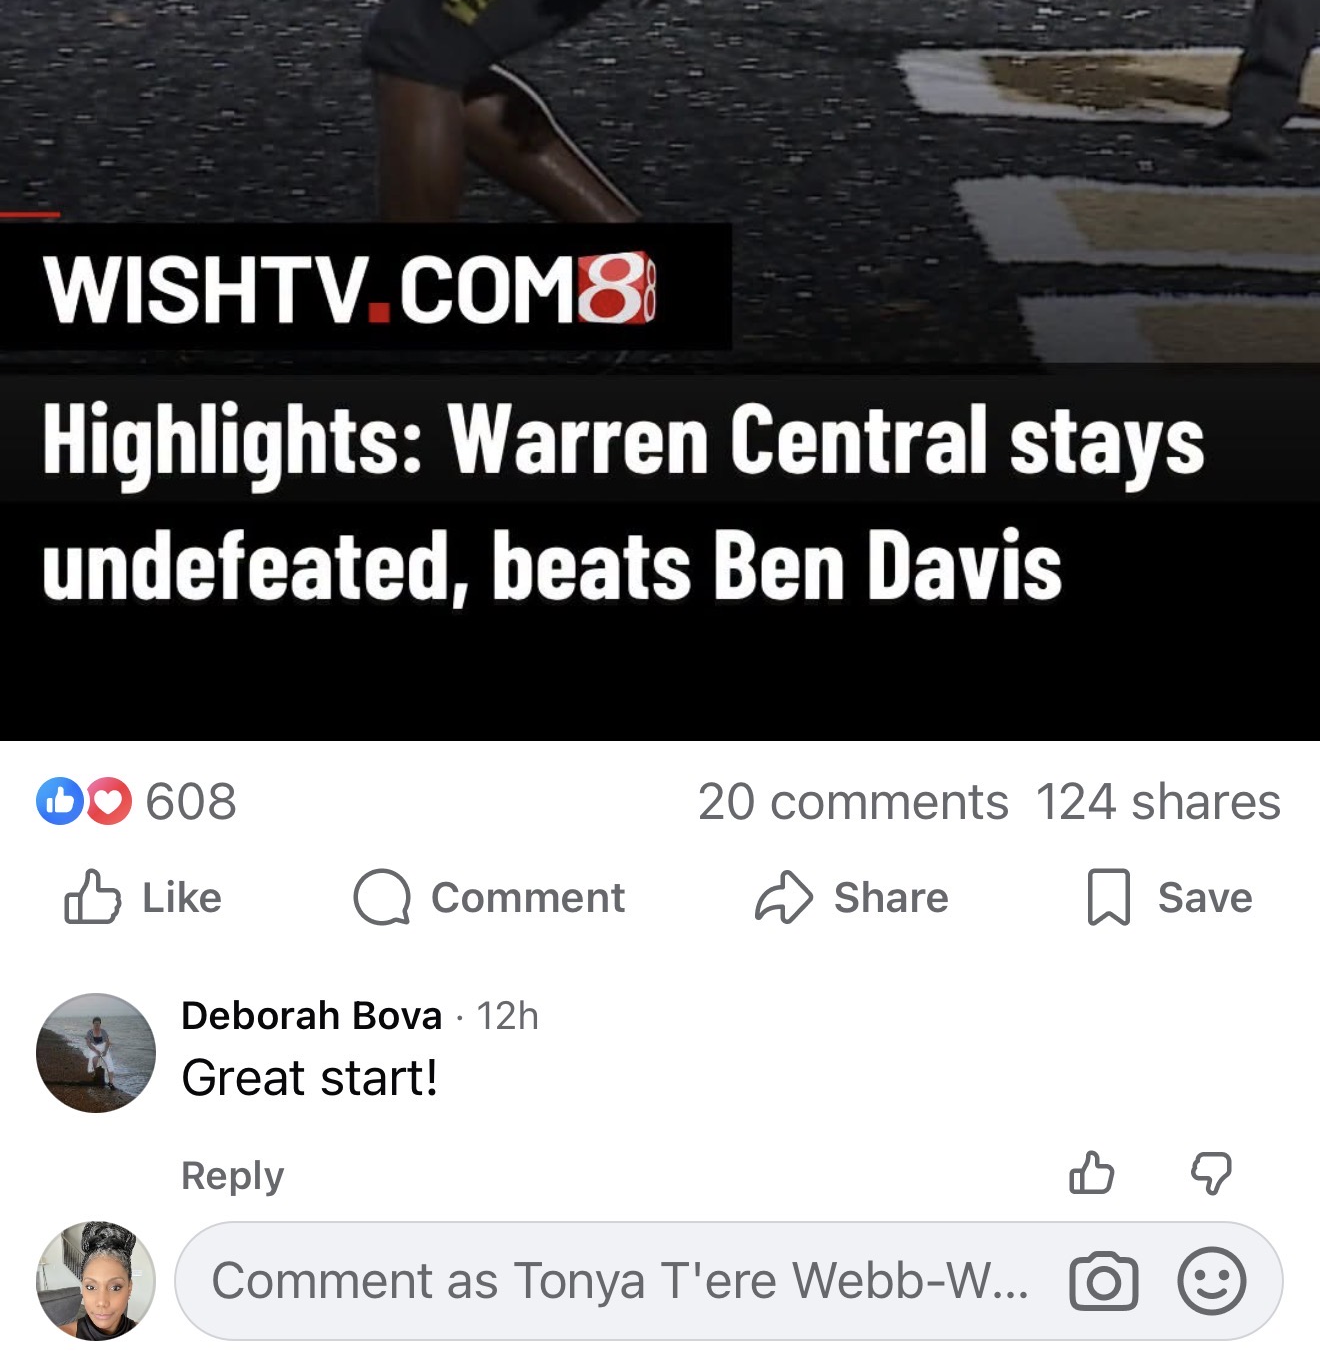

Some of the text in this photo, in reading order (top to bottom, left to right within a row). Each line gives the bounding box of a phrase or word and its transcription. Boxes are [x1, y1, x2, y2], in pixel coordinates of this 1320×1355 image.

[147, 782, 235, 820] 608
[700, 782, 1008, 820] 20 comments
[1038, 781, 1280, 820] 124 shares
[145, 880, 221, 913] Like
[432, 882, 625, 913] Comment
[835, 881, 948, 913] Share
[1159, 882, 1252, 913] Save
[183, 1000, 537, 1030] Deborah Bova 12h
[183, 1058, 438, 1096] Great start!
[183, 1160, 284, 1197] Reply
[213, 1261, 432, 1299] Comment
[448, 1271, 497, 1299] as
[514, 1262, 643, 1308] Tonya
[661, 1262, 776, 1299] T'ere
